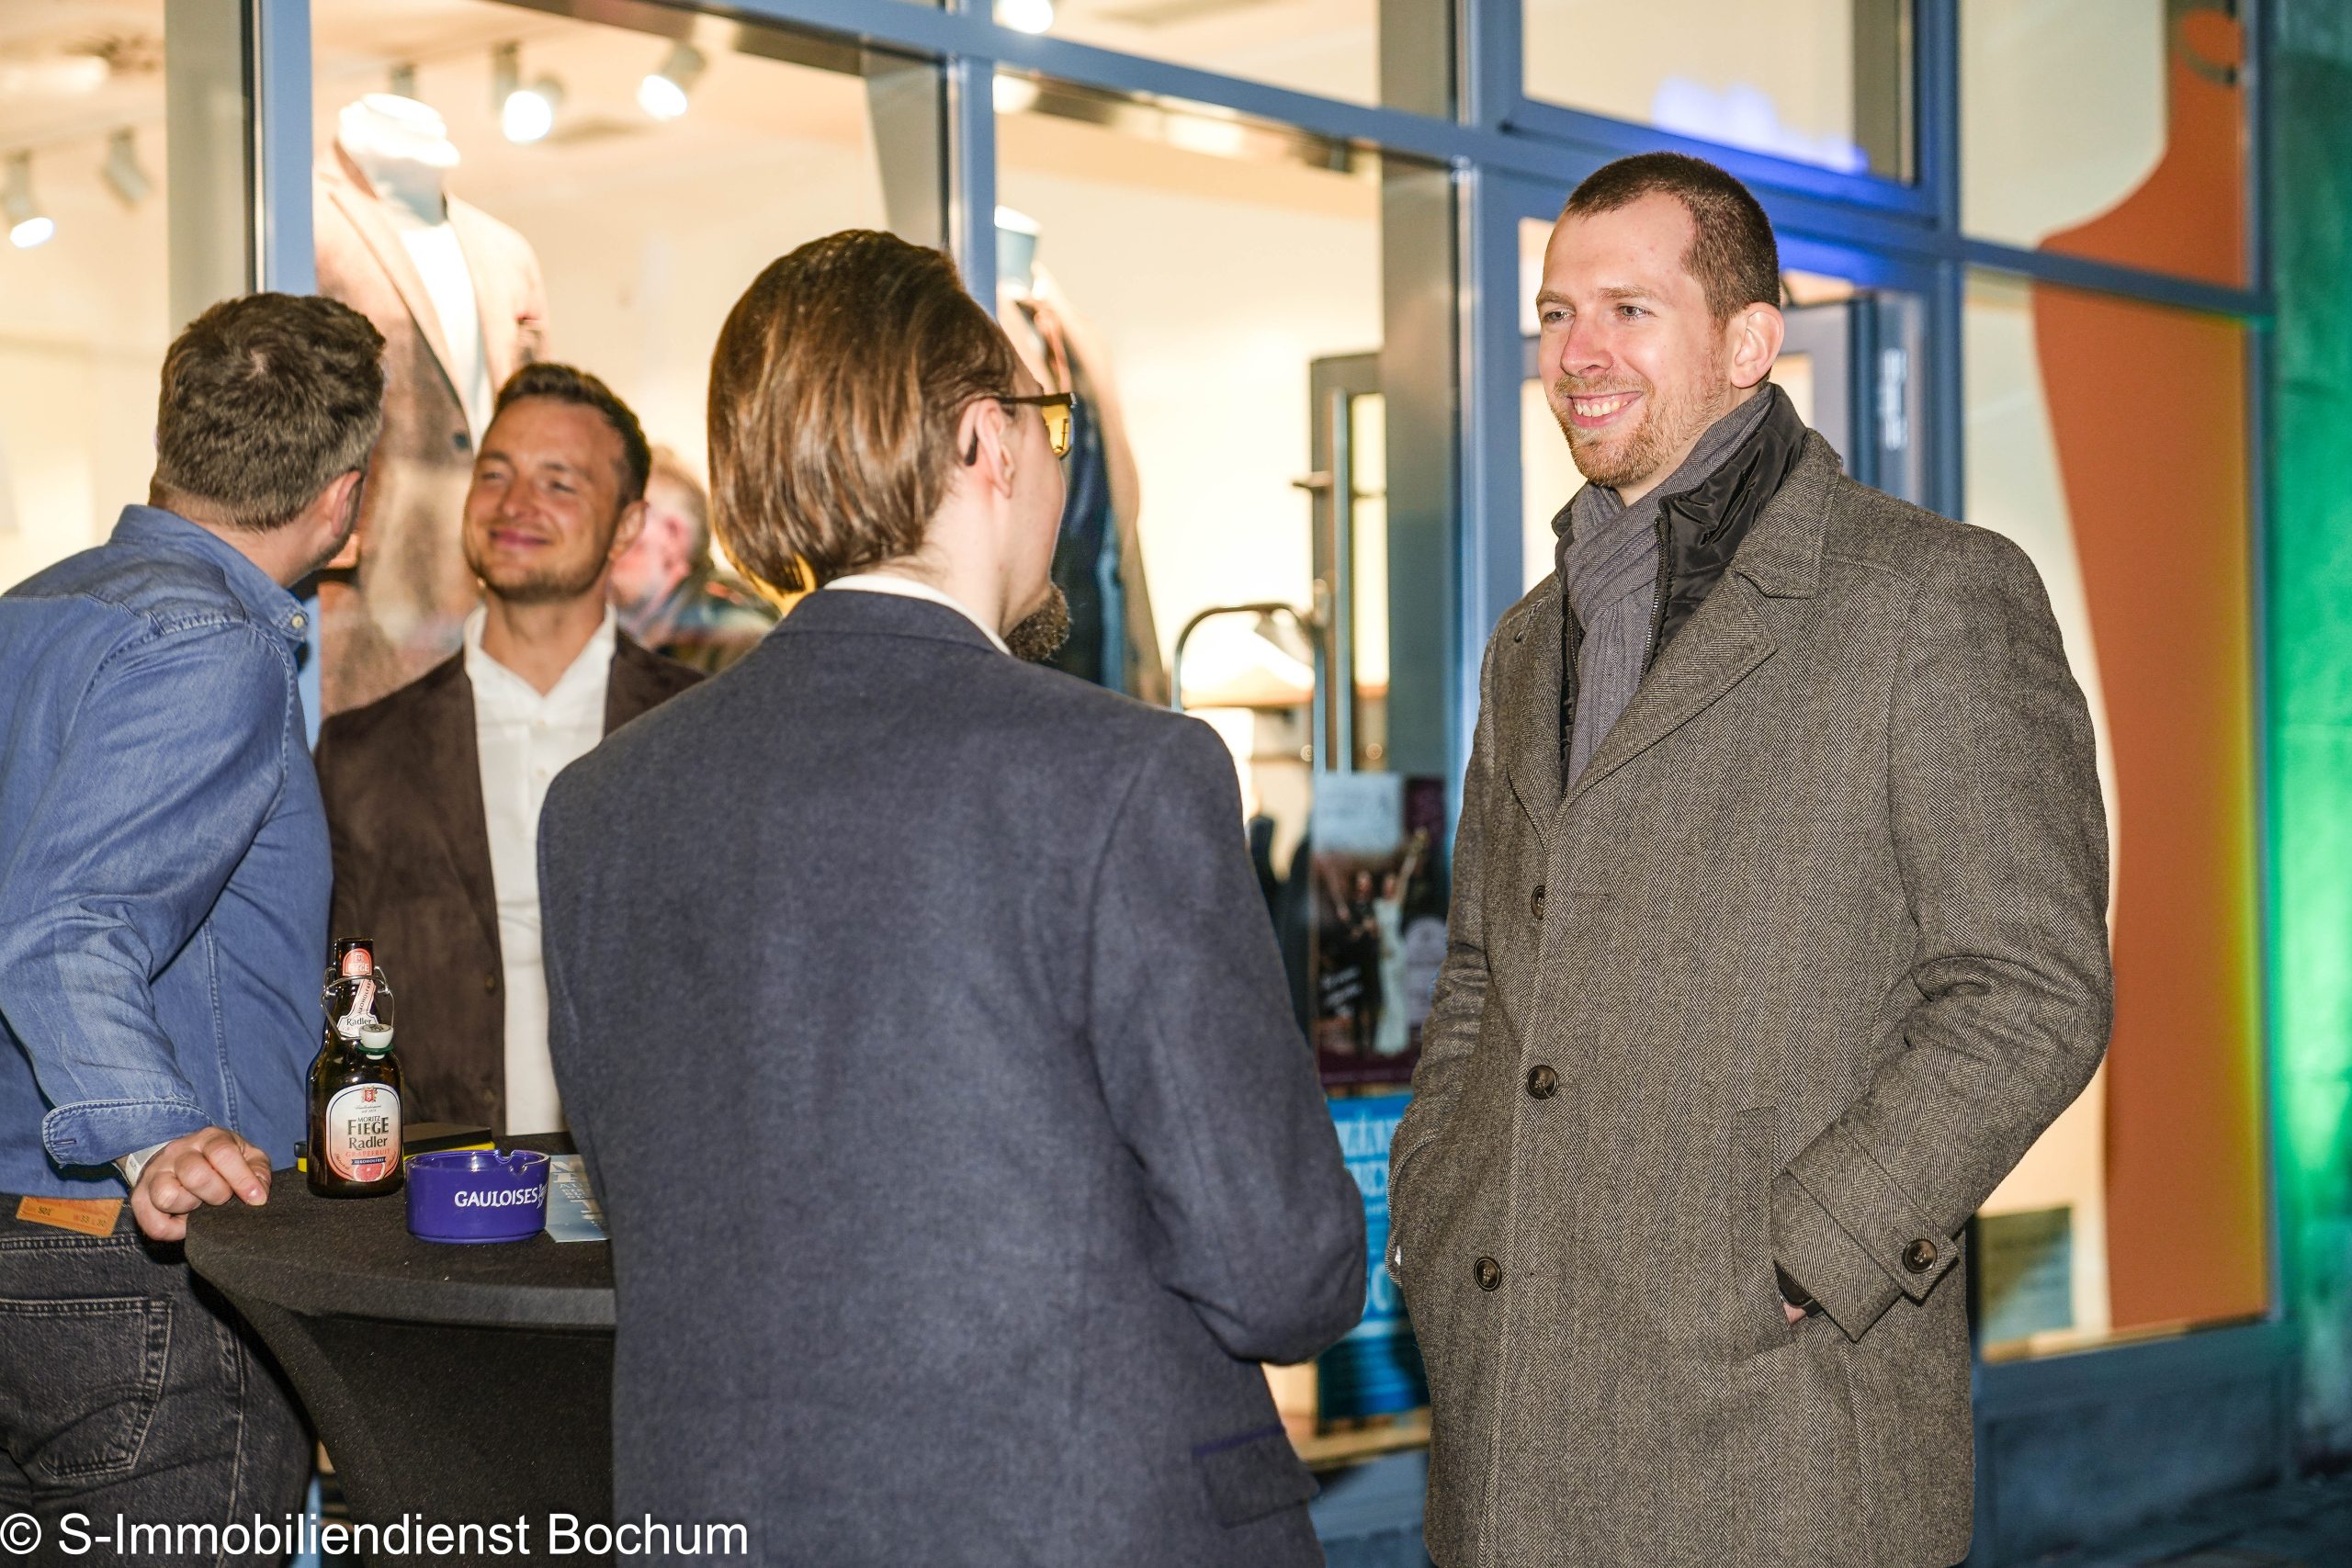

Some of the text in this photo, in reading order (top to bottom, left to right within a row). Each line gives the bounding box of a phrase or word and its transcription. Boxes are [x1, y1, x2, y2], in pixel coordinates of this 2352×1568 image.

[346, 1017, 372, 1026] Radler
[347, 1116, 390, 1135] FIEGE
[348, 1135, 388, 1150] Radler
[454, 1187, 537, 1208] GAULOISES
